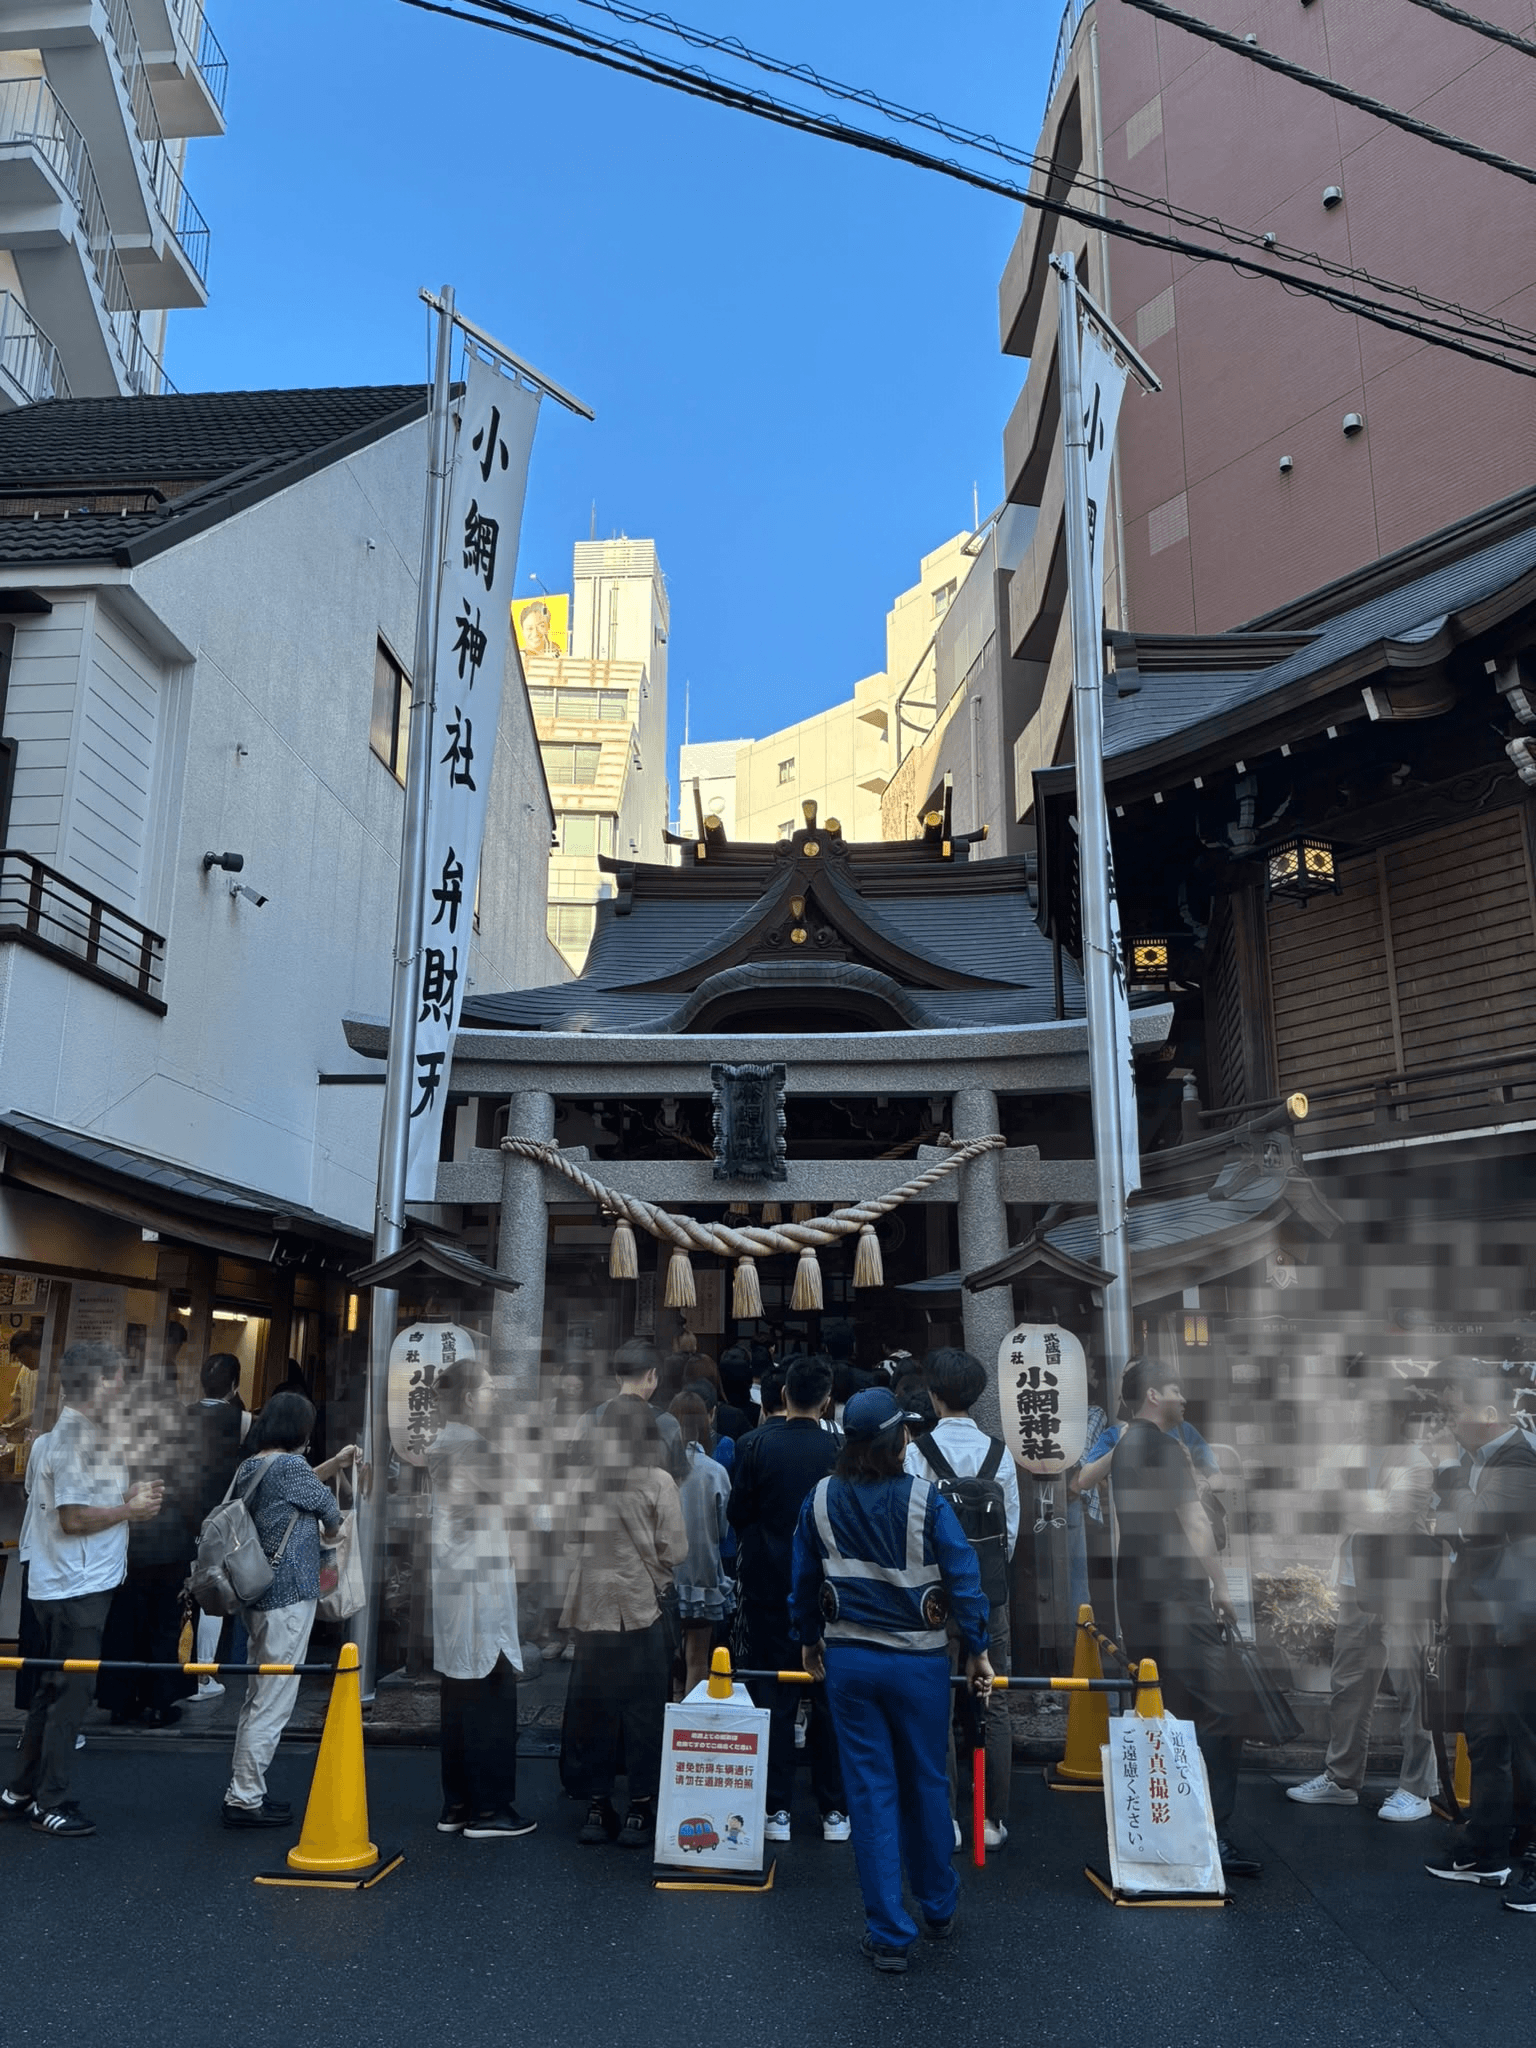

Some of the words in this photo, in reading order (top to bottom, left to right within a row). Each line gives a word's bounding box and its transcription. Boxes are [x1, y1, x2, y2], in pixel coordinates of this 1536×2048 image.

[440, 405, 509, 791] 小網神社
[411, 846, 464, 1118] 弁財天
[1016, 1366, 1065, 1461] 小網神社
[1122, 1728, 1144, 1852] ご遠慮ください。
[1145, 1729, 1171, 1825] 写真撮影
[1170, 1731, 1191, 1796] 道路での
